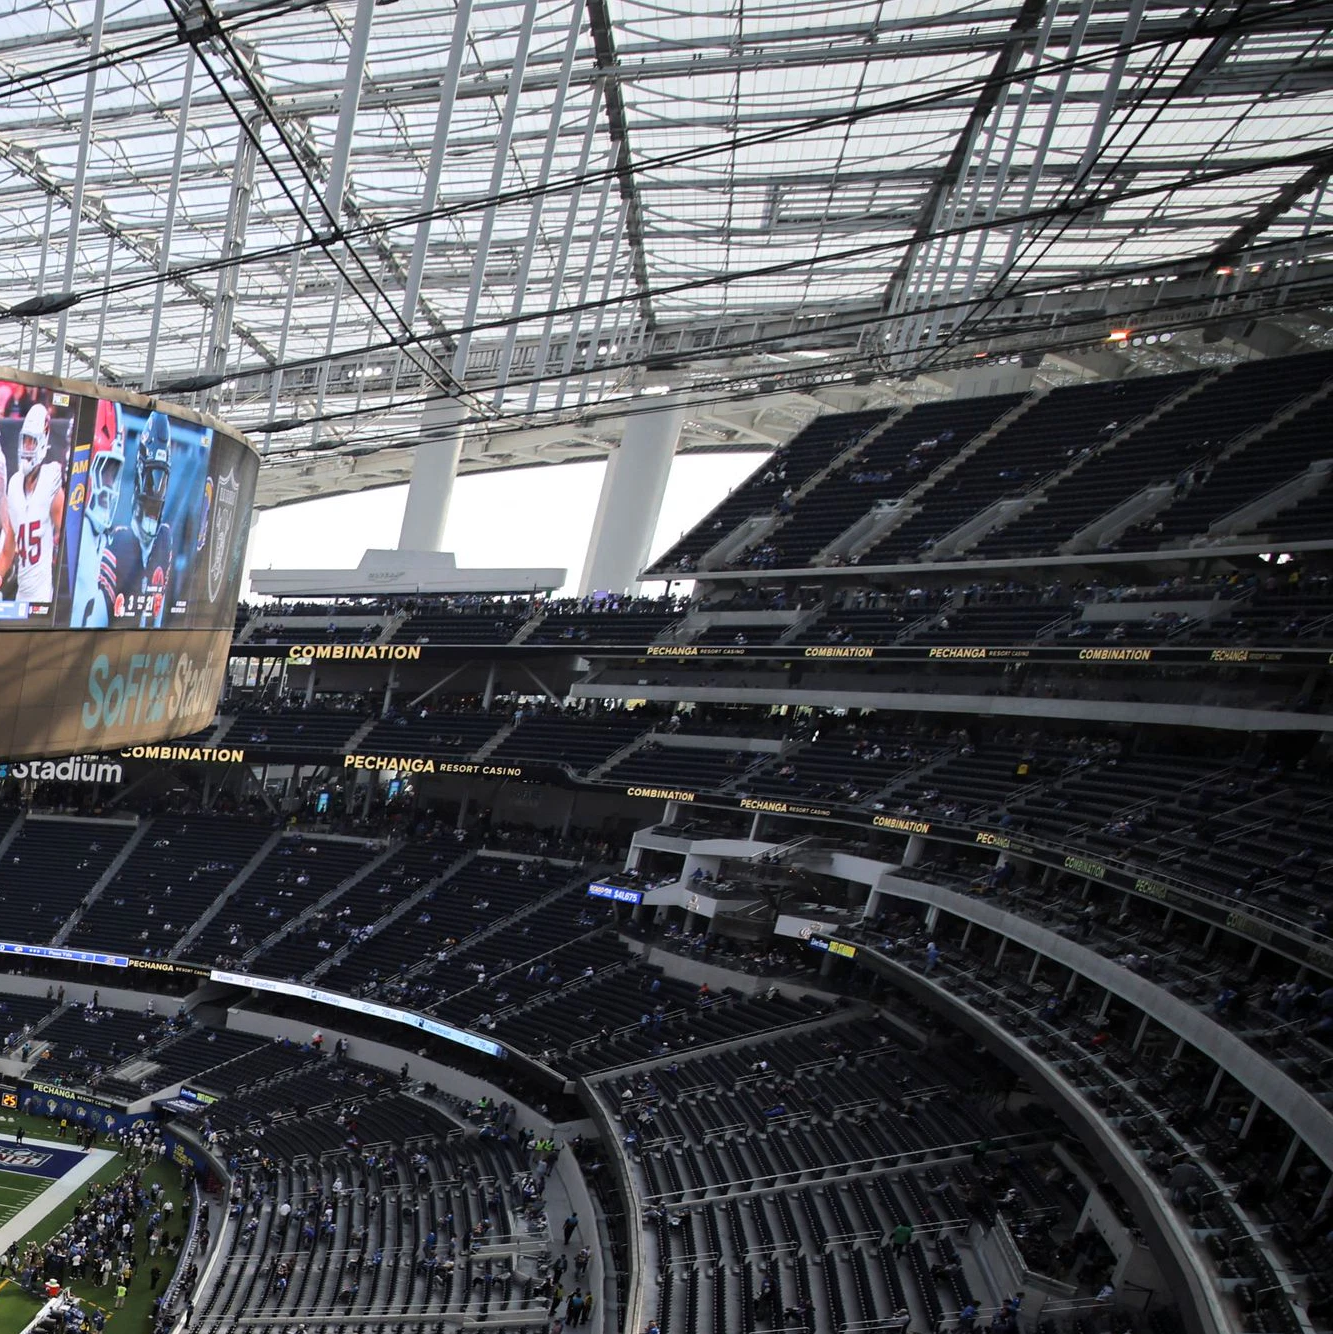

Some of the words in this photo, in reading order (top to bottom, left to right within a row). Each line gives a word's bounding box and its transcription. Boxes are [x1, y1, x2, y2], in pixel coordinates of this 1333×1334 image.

[16, 520, 42, 568] 45
[127, 594, 135, 610] 3
[289, 644, 422, 660] COMBINATION
[646, 646, 699, 656] PECHANGA
[804, 647, 875, 658] COMBINATION
[929, 648, 987, 658] PECHANGA
[1078, 648, 1151, 660] COMBINATION
[83, 654, 150, 730] SoFi
[343, 754, 435, 773] PECHANGA
[439, 762, 480, 773] RESORT
[482, 766, 522, 776] CASINO
[627, 786, 695, 802] COMBINATION
[740, 798, 787, 813] PECHANGA
[872, 815, 930, 834] COMBINATION
[128, 958, 175, 972] PECHANGA
[3, 1095, 16, 1106] 25
[33, 1083, 76, 1100] PECHANGA
[77, 1095, 94, 1104] RESORT
[94, 1099, 112, 1109] CASINO
